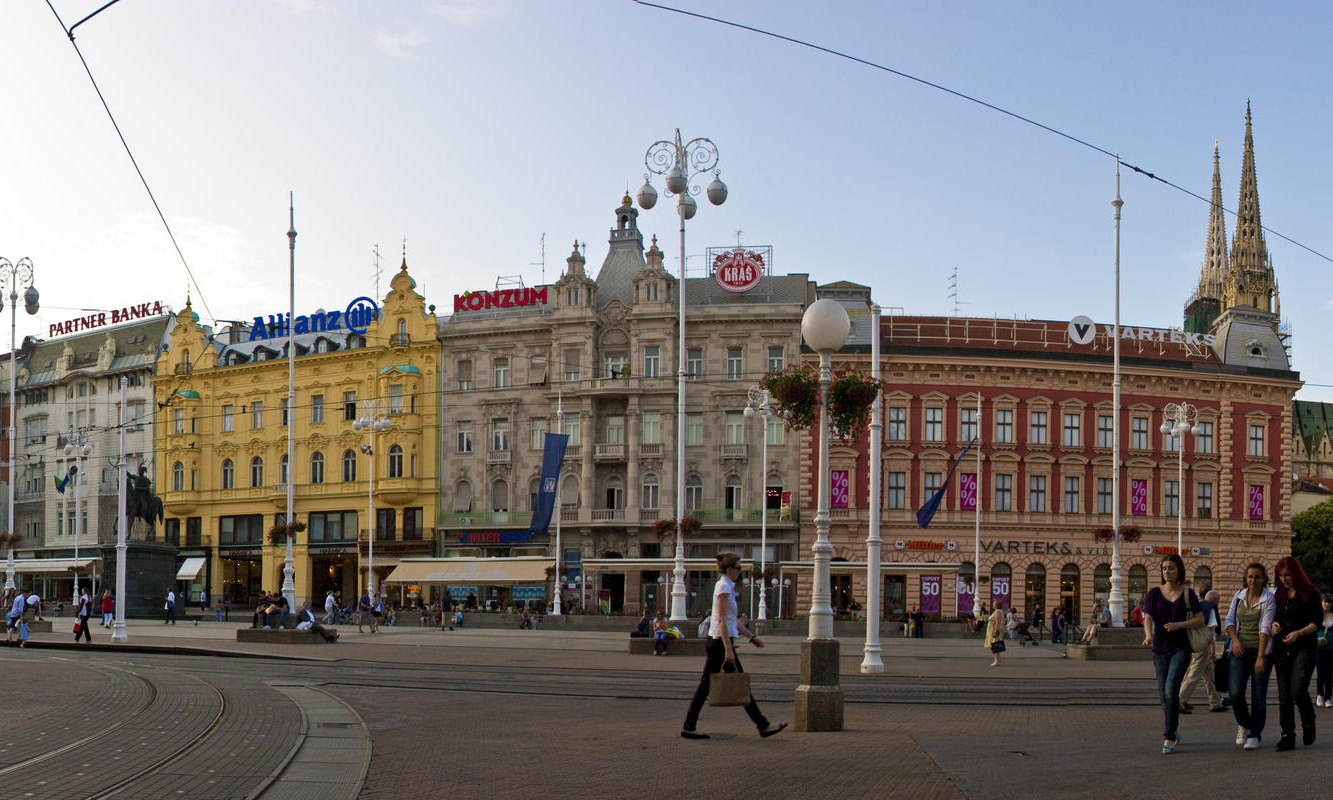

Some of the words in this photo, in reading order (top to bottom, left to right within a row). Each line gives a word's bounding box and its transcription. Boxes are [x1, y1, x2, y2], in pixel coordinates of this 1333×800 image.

[453, 286, 548, 312] KONZUM
[49, 312, 107, 338] PARTNER
[111, 300, 162, 324] BANKA
[249, 310, 341, 341] Allianz
[1104, 325, 1217, 346] VARTEKS
[922, 582, 940, 596] 50
[992, 582, 1009, 595] 50
